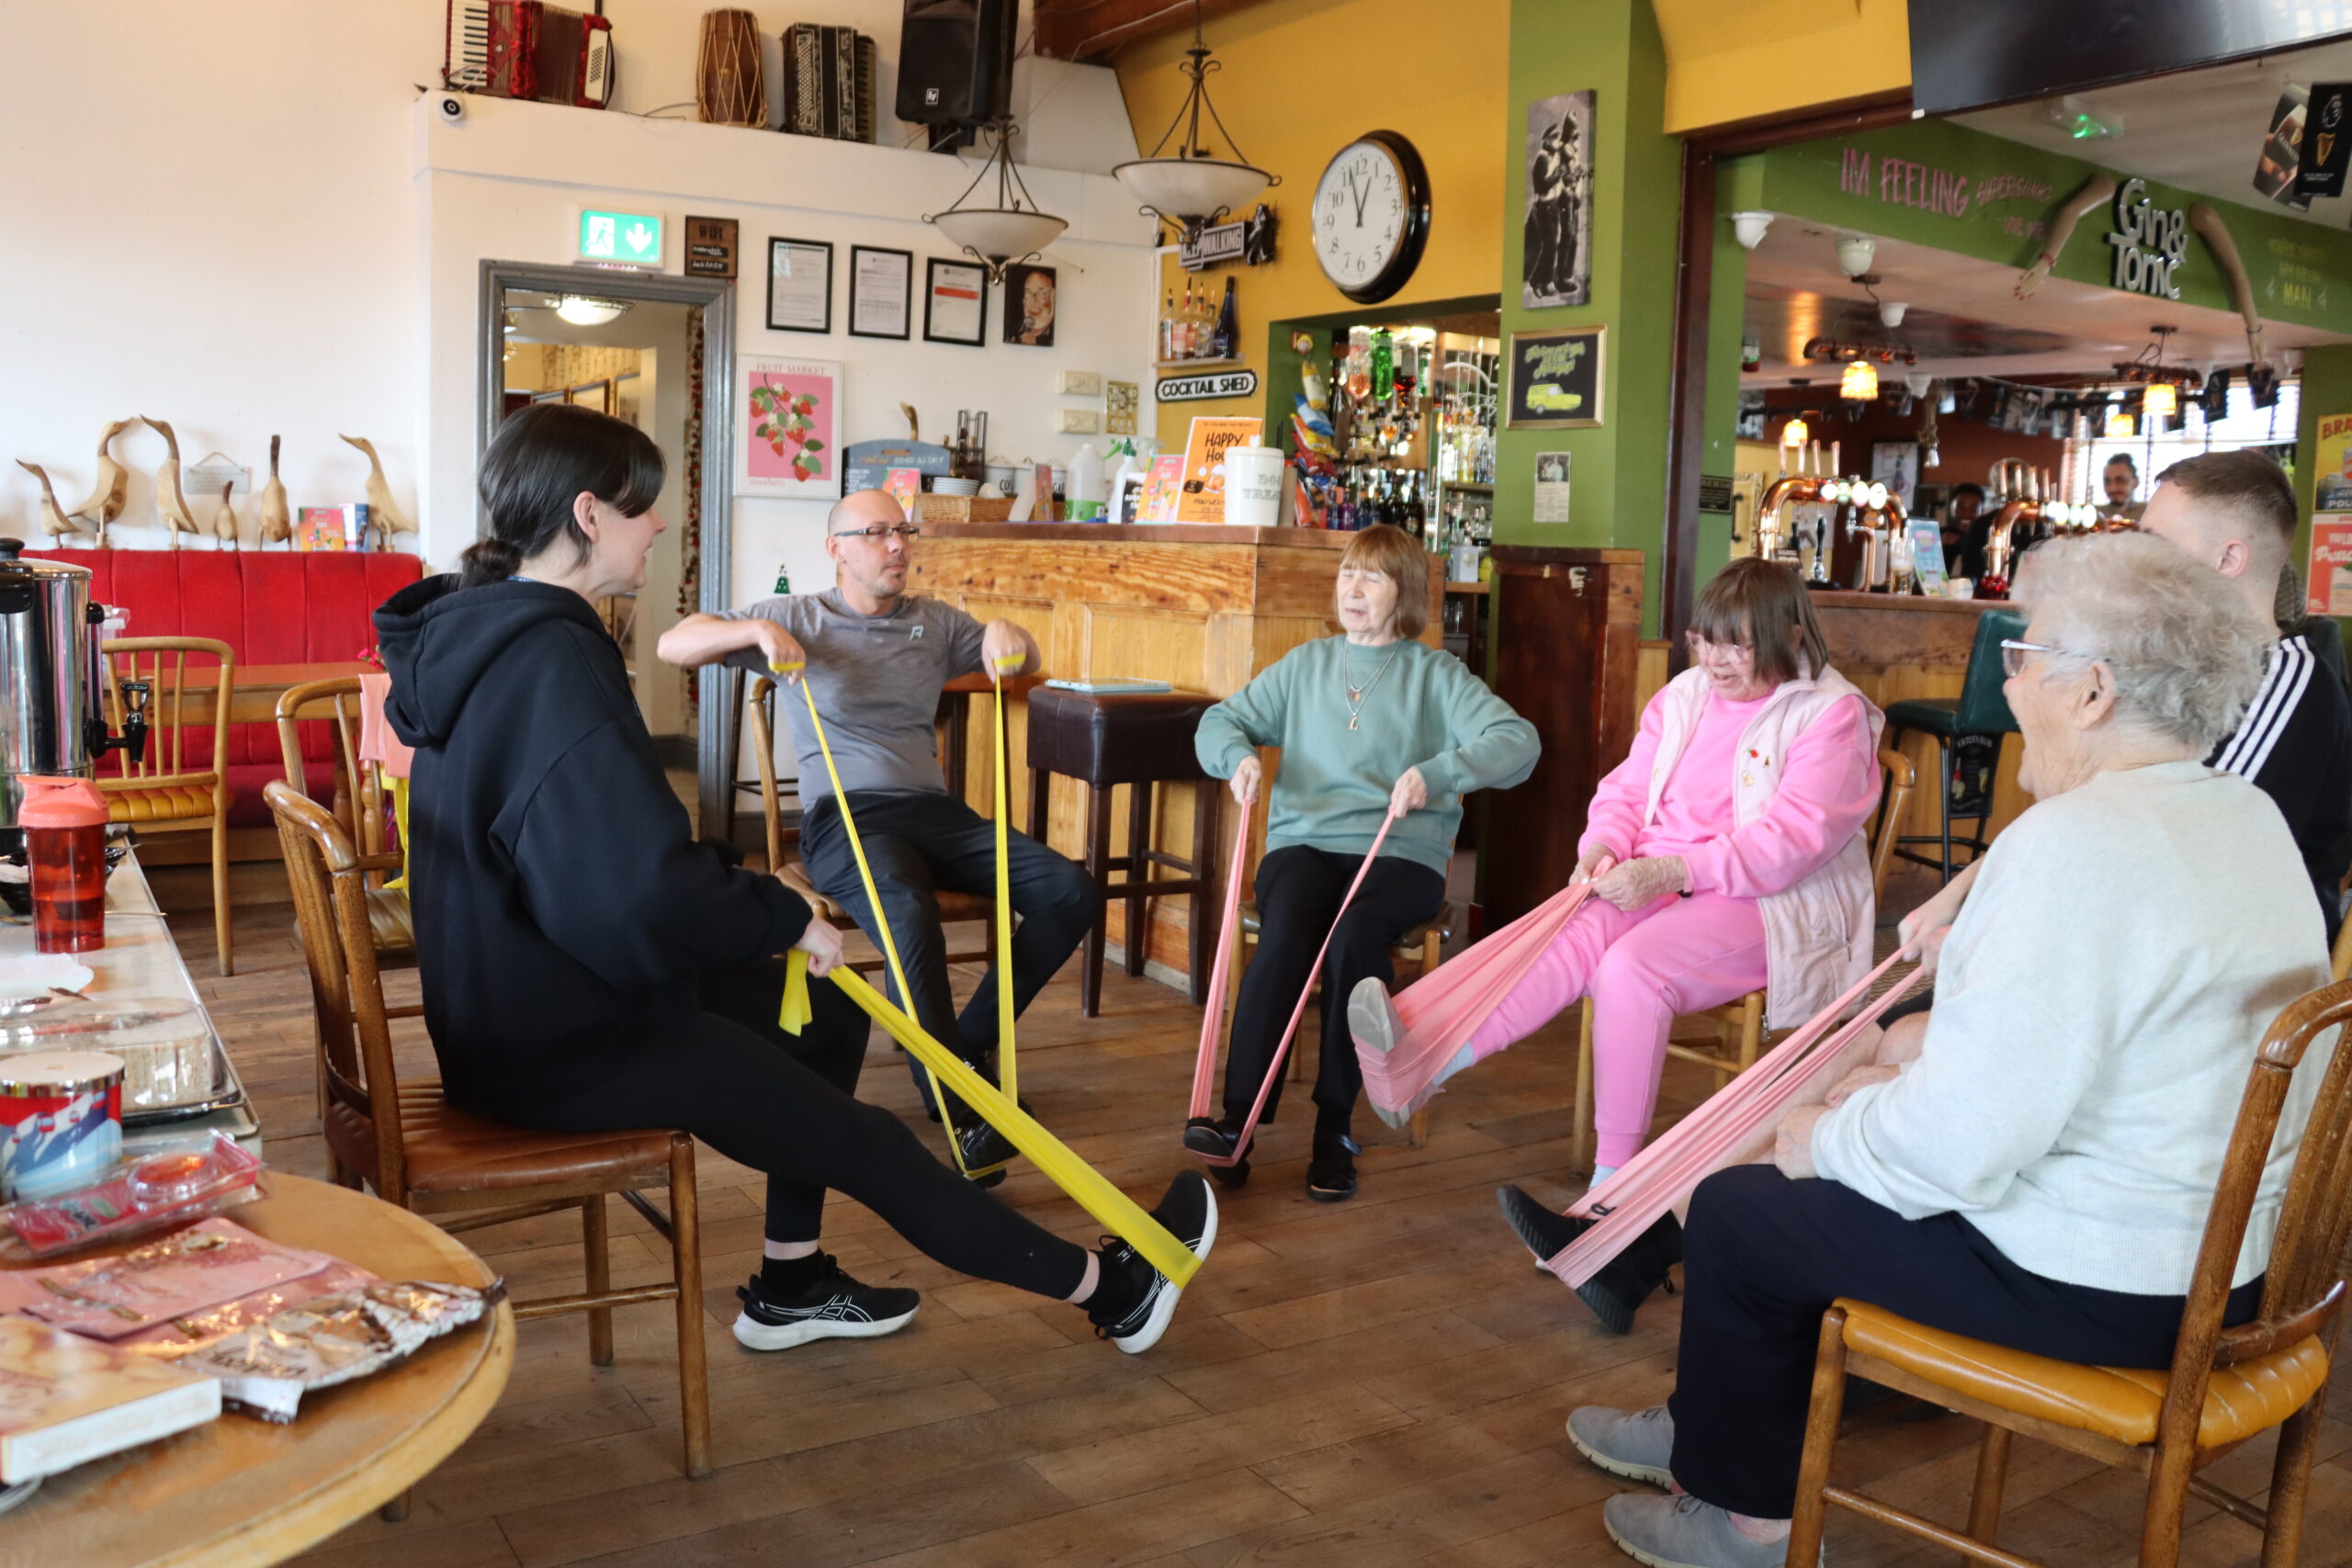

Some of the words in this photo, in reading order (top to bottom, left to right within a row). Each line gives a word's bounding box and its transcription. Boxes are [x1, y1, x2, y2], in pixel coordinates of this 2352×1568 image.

[1356, 157, 1368, 175] 12
[1384, 175, 1392, 191] 2
[1881, 157, 1970, 218] FEELING
[1331, 190, 1344, 209] 10
[1390, 198, 1398, 217] 3
[1327, 214, 1335, 231] 9
[1384, 224, 1392, 240] 4
[1204, 227, 1242, 256] WALKING
[1330, 237, 1340, 254] 8
[1343, 251, 1351, 269] 7
[1374, 244, 1383, 263] 5
[1356, 255, 1366, 273] 6
[757, 362, 782, 373] FRUIT
[787, 365, 824, 376] MARKET
[1161, 378, 1217, 397] COCKTAIL
[1219, 376, 1250, 393] SHED
[1204, 432, 1244, 447] HAPPY
